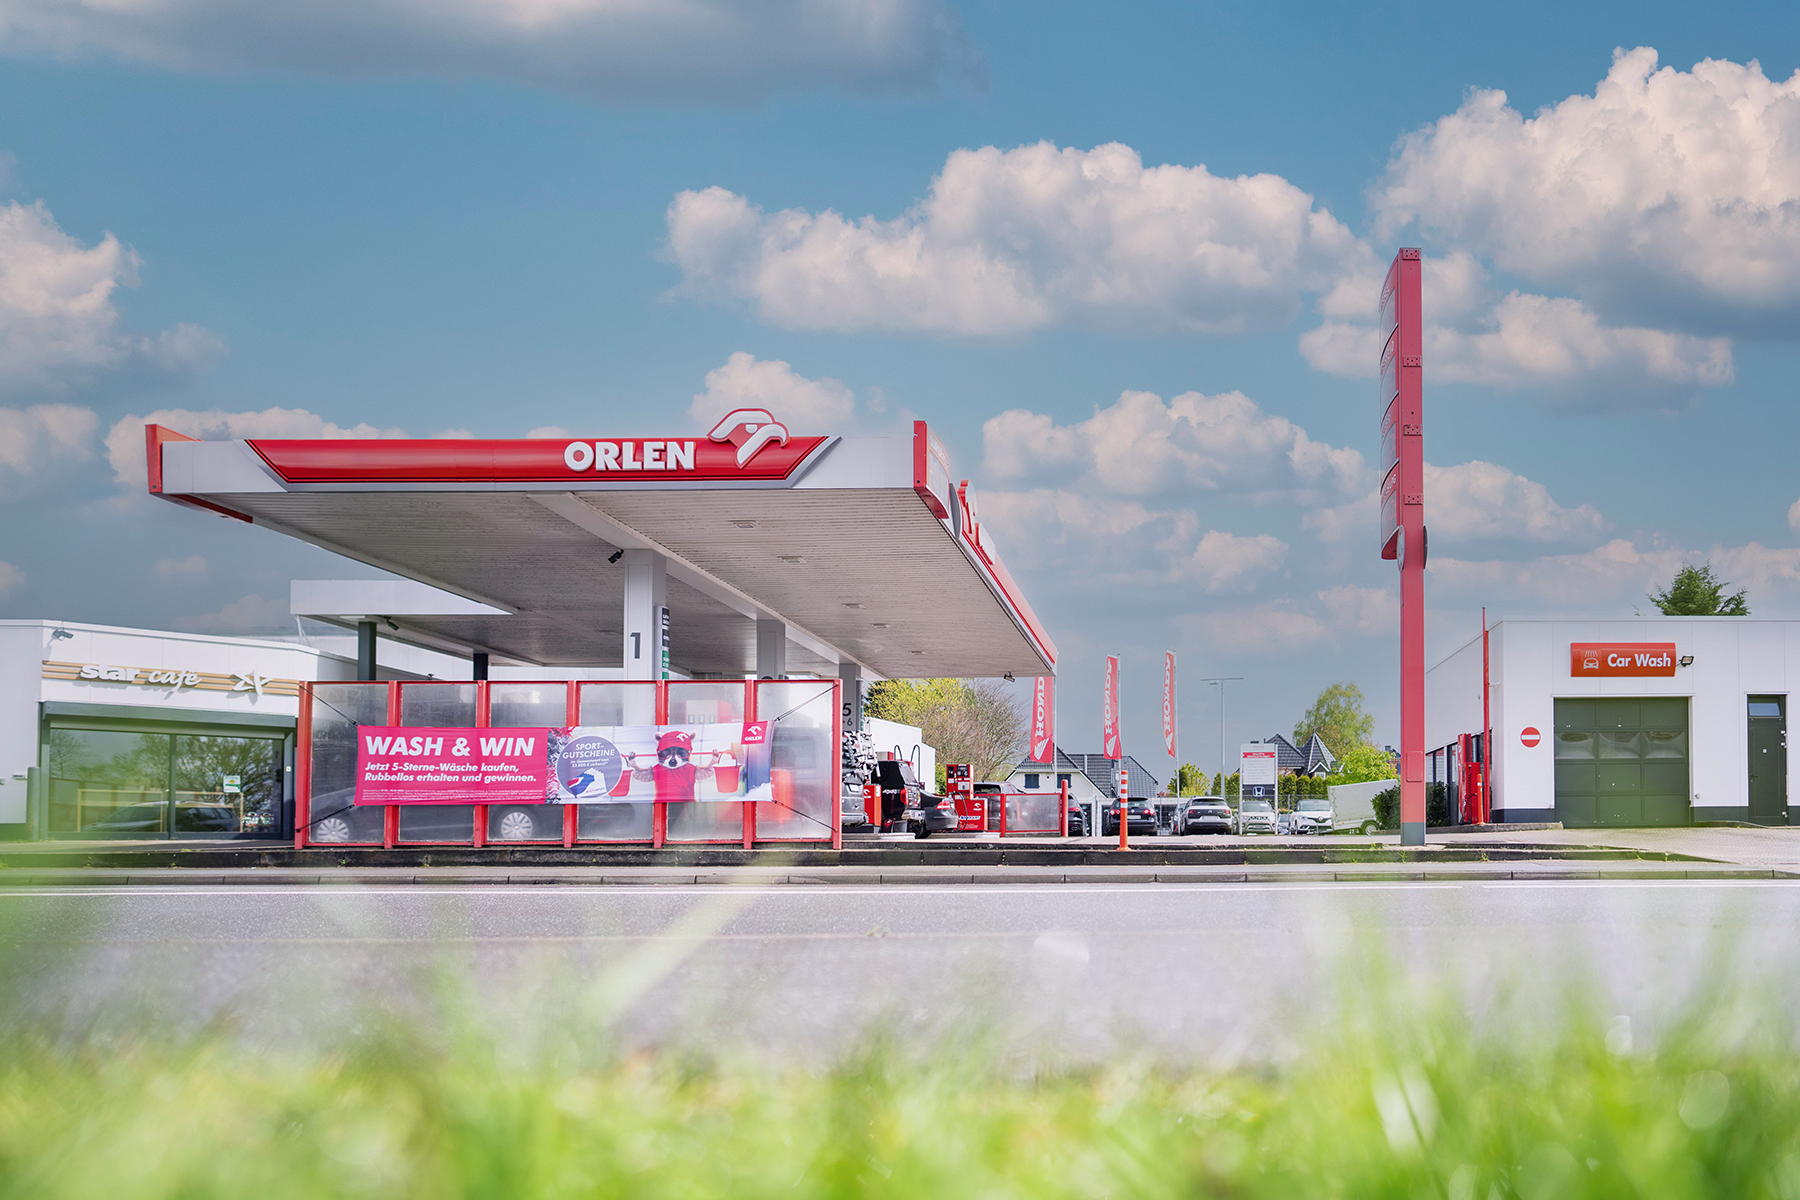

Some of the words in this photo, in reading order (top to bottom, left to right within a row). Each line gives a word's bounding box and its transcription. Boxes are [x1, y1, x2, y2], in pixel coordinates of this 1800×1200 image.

[564, 441, 695, 471] ORLEN
[630, 632, 641, 659] 1
[1607, 653, 1631, 667] Car
[1634, 652, 1671, 667] Wash
[80, 664, 140, 682] star
[148, 669, 202, 690] café
[843, 703, 851, 716] 5
[847, 718, 853, 726] 6
[365, 736, 443, 756] WASH
[451, 737, 470, 756] &
[479, 737, 535, 756] WIN
[562, 749, 615, 759] GUTSCHEINE
[365, 762, 389, 771] Jetzt
[391, 762, 478, 772] 5-Sterne-Wäsche
[480, 762, 519, 772] kaufen,
[365, 773, 414, 782] Rubbellos
[416, 773, 459, 782] erhalten
[462, 773, 481, 782] und
[484, 774, 537, 783] gewinnen.
